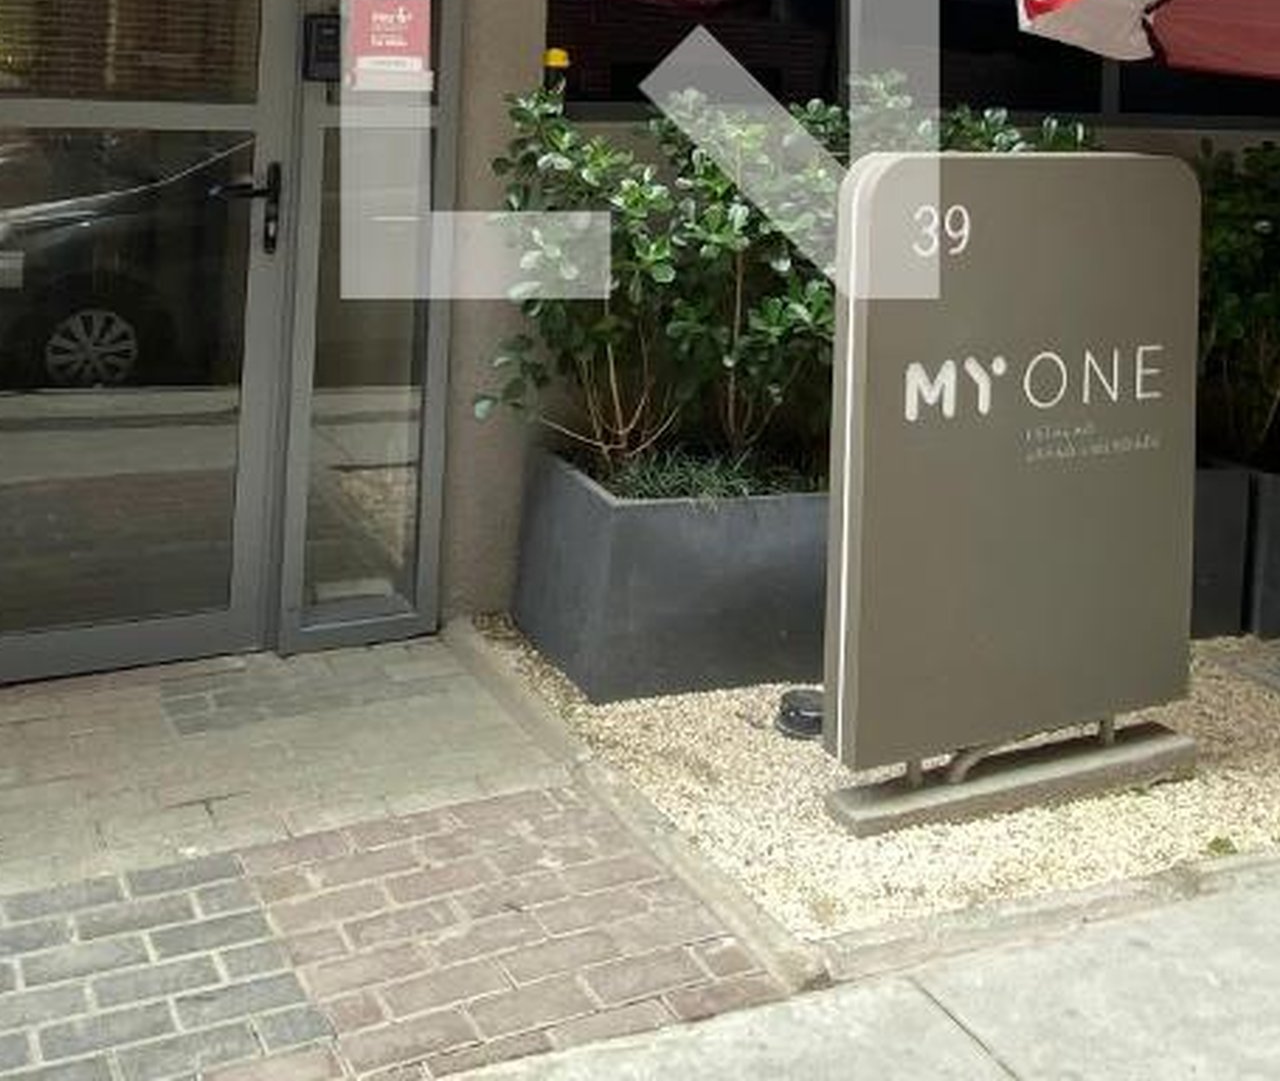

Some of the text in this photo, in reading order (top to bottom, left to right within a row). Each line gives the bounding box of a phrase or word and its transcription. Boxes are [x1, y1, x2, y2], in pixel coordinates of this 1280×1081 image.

[912, 204, 970, 257] 39
[904, 344, 1164, 422] MY ONE
